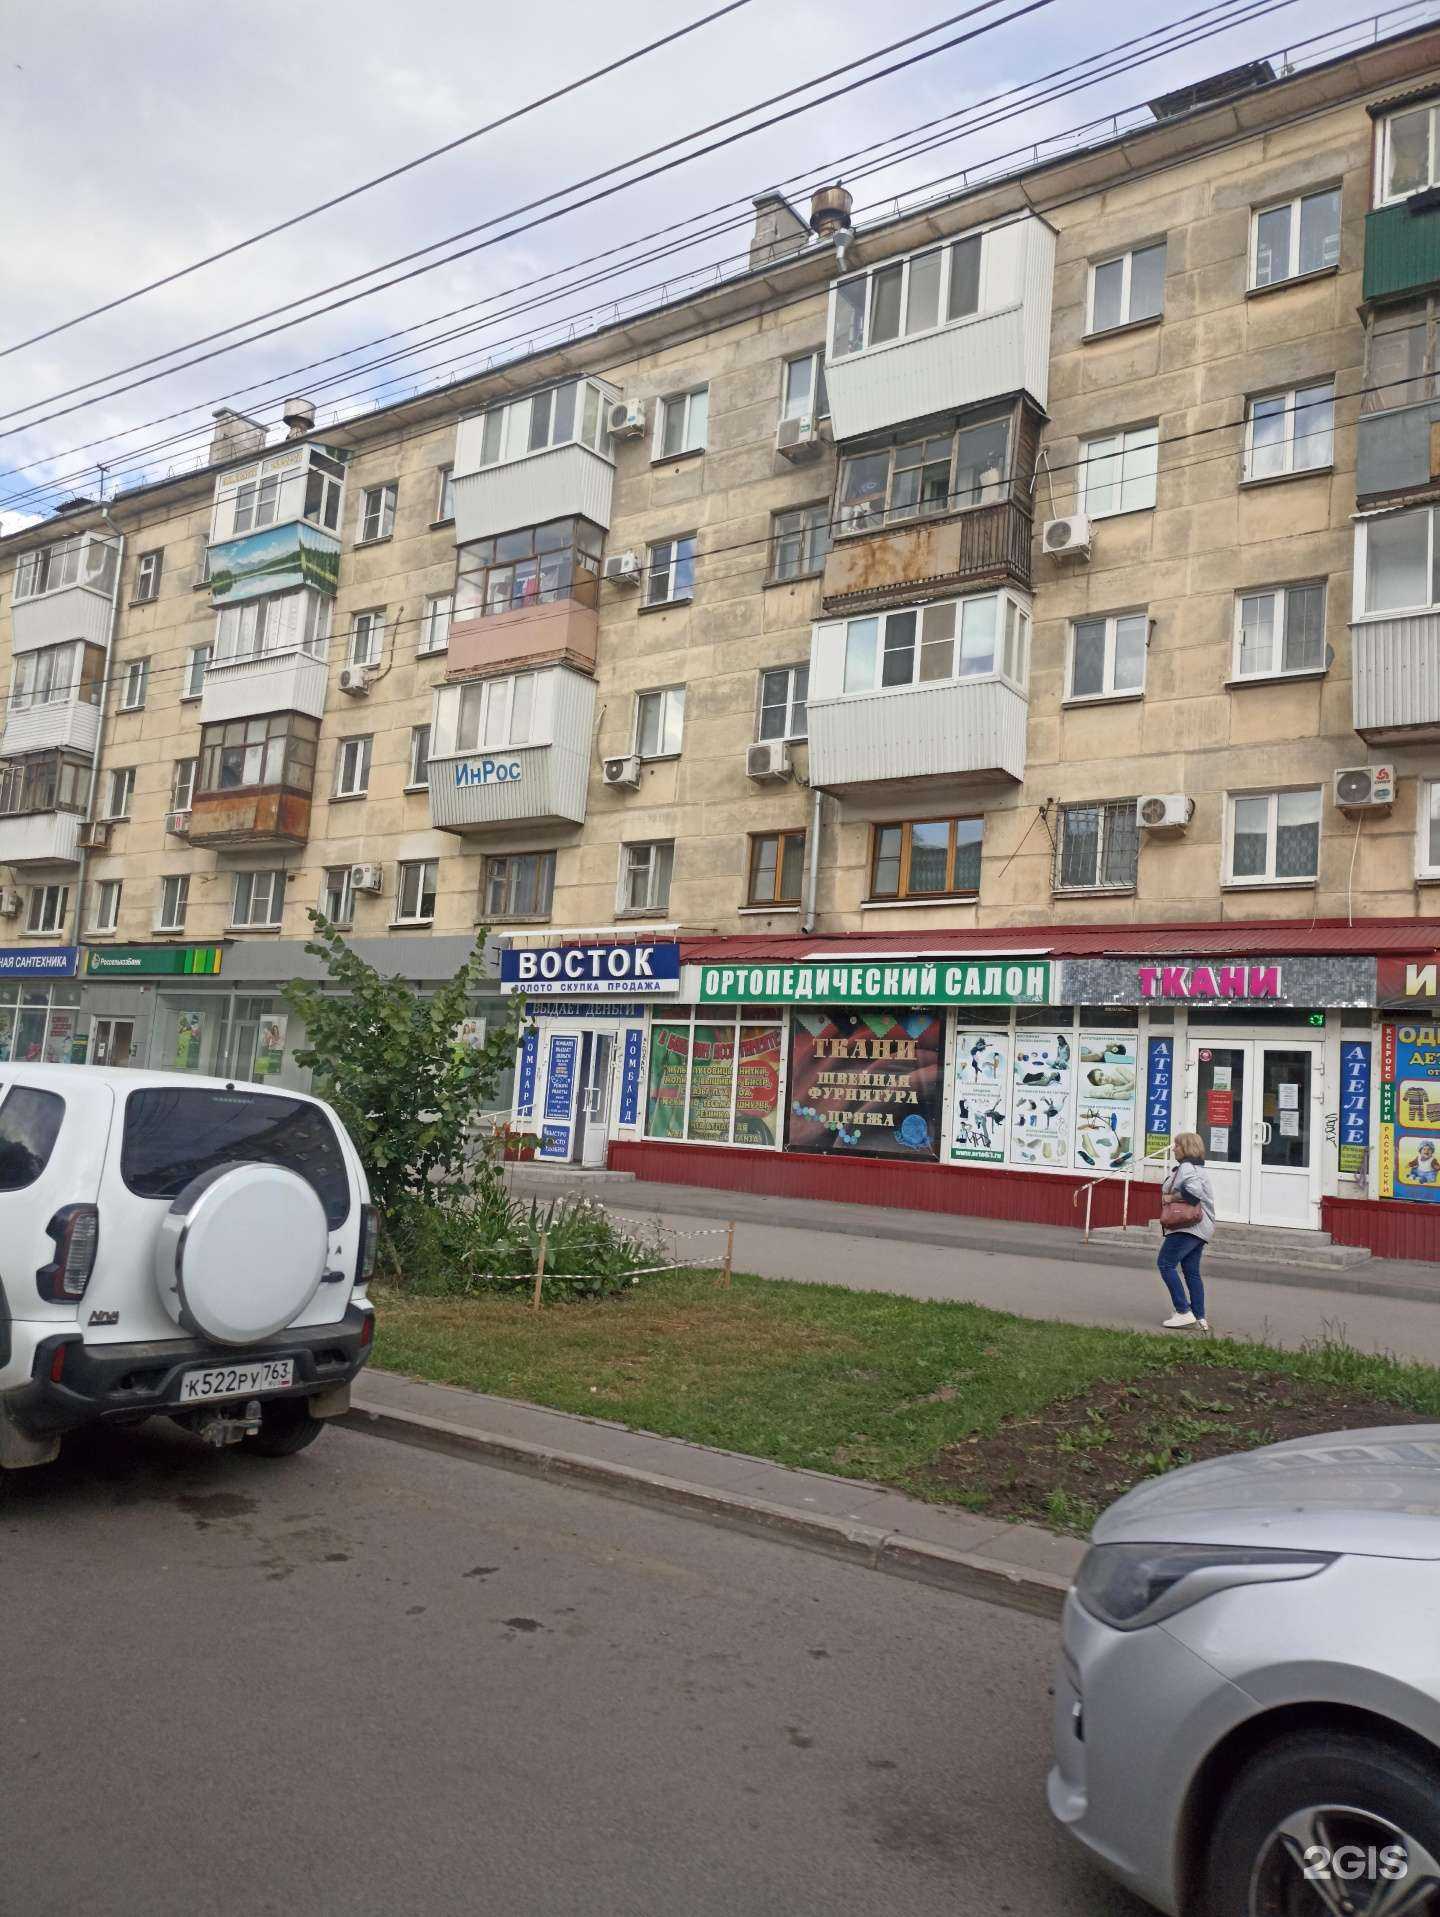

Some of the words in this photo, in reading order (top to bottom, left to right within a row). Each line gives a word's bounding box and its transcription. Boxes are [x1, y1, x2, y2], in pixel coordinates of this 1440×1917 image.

[455, 760, 521, 786] ИнРос
[15, 955, 67, 968] САНТЕХНИКА
[519, 948, 654, 979] ВОСТОК
[514, 983, 553, 993] ЗОЛОТО
[560, 982, 600, 993] СКУПКА
[607, 980, 661, 992] ПРОДАЖА
[705, 963, 938, 999] ОРТОПЕДИЧЕСКИЙ
[945, 966, 1045, 997] САЛОН
[1138, 966, 1281, 998] ТКАНИ
[585, 1003, 635, 1017] ДЕНЬГИ
[813, 1038, 919, 1061] ТКАНИ
[624, 1033, 637, 1121] ЛОМБАРД
[816, 1070, 912, 1088] ШВЕЙНАЯ
[1149, 1042, 1170, 1132] АТЕЛЬЕ
[807, 1086, 919, 1105] ФУРНИТУРА
[1343, 1046, 1367, 1143] АТЕЛЬЕ
[827, 1110, 895, 1127] ПРЯЖА
[264, 1363, 288, 1381] 763
